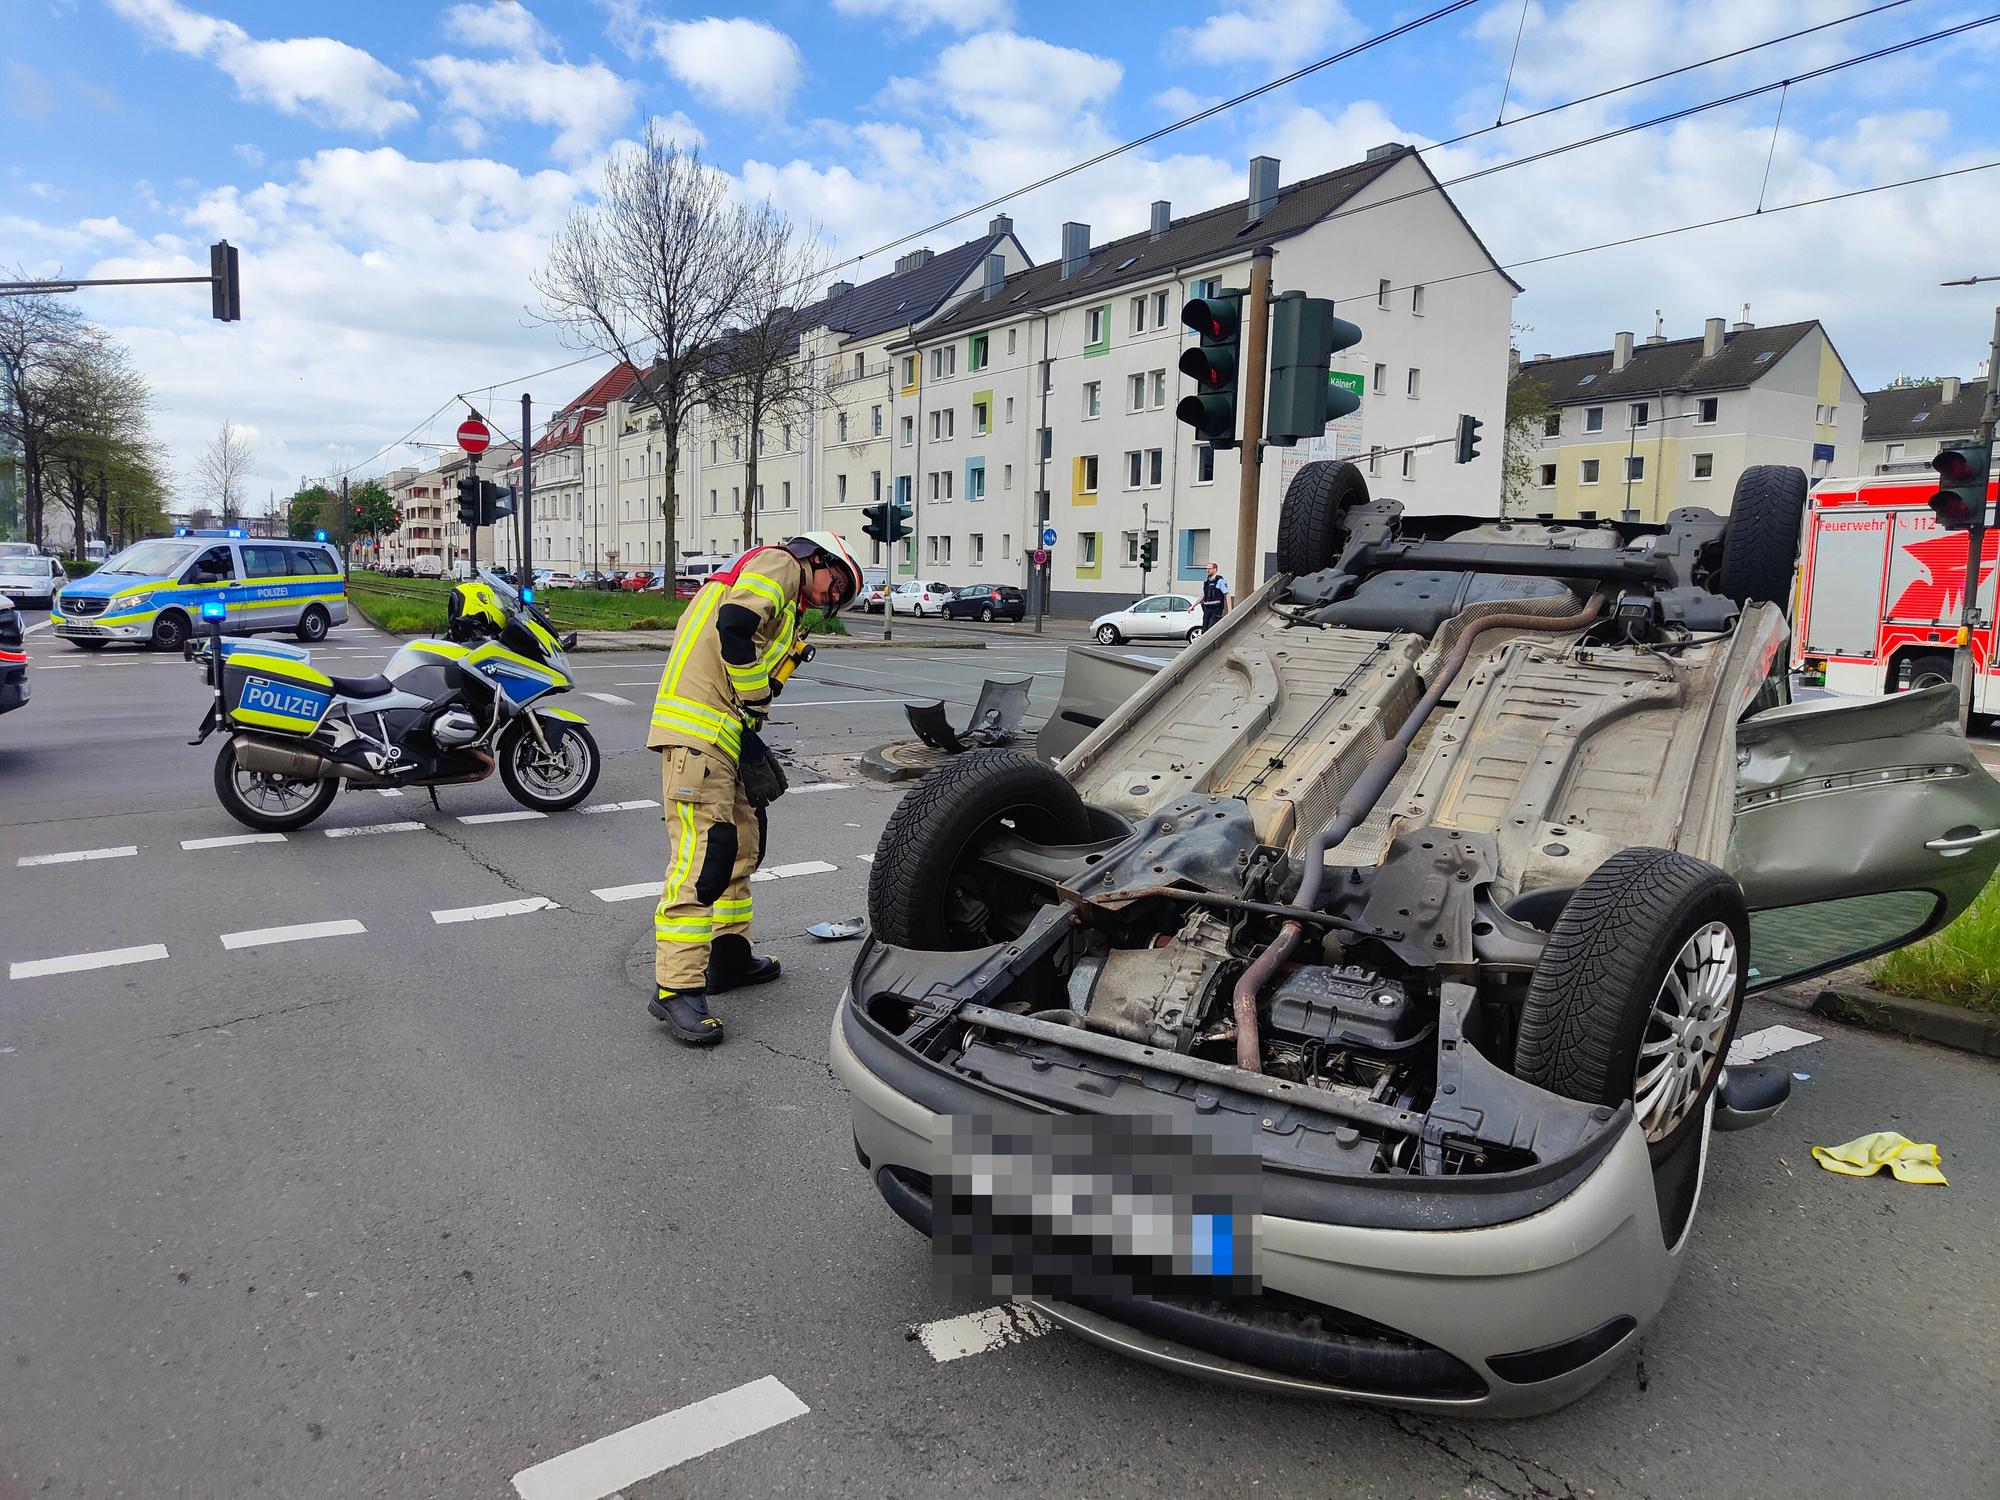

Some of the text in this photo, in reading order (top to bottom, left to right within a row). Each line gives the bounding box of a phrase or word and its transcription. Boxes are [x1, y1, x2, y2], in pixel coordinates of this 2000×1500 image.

[1330, 377, 1357, 389] Kölner?
[1819, 516, 1936, 531] Feuerwehr 112
[257, 587, 288, 598] POLIZEI
[247, 687, 320, 718] POLIZEI
